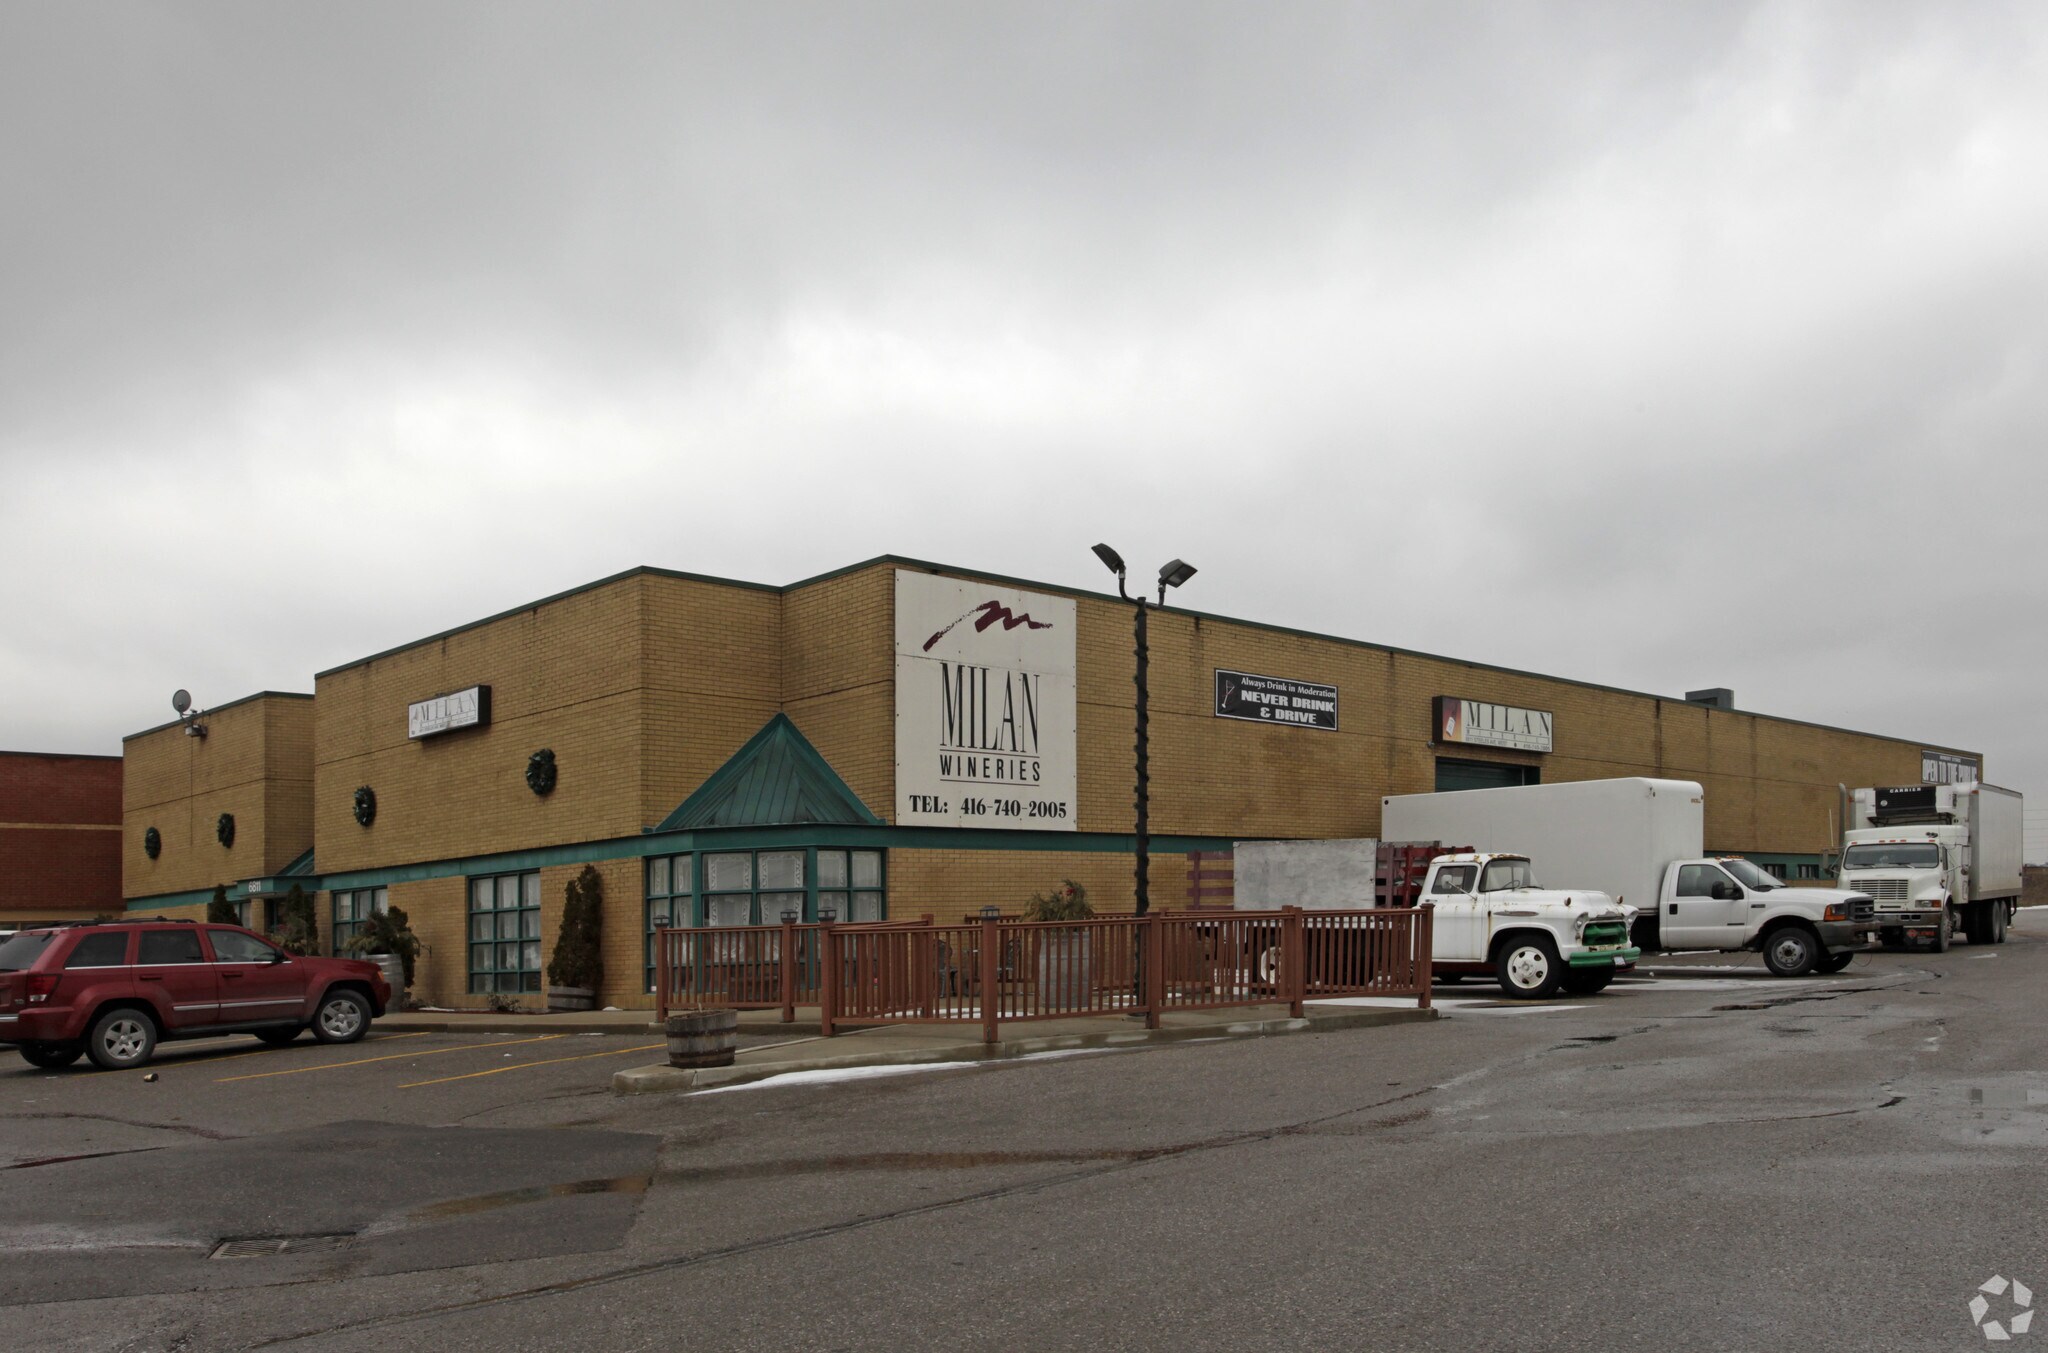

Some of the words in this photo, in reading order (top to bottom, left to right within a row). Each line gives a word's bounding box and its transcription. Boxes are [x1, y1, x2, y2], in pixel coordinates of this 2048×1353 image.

[1241, 677, 1265, 690] Always
[1267, 681, 1287, 692] Drink
[1288, 683, 1295, 692] in
[1297, 686, 1336, 698] Moderation
[940, 662, 1040, 753] MILAN
[1241, 690, 1289, 707] NEVER
[1292, 697, 1335, 712] DRINK
[1260, 707, 1271, 718] &
[1275, 708, 1317, 724] DRIVE
[1466, 701, 1550, 736] MILAN
[940, 755, 1040, 782] WINERIES
[909, 795, 948, 814] TEL:
[961, 798, 1067, 818] 416-740-2005
